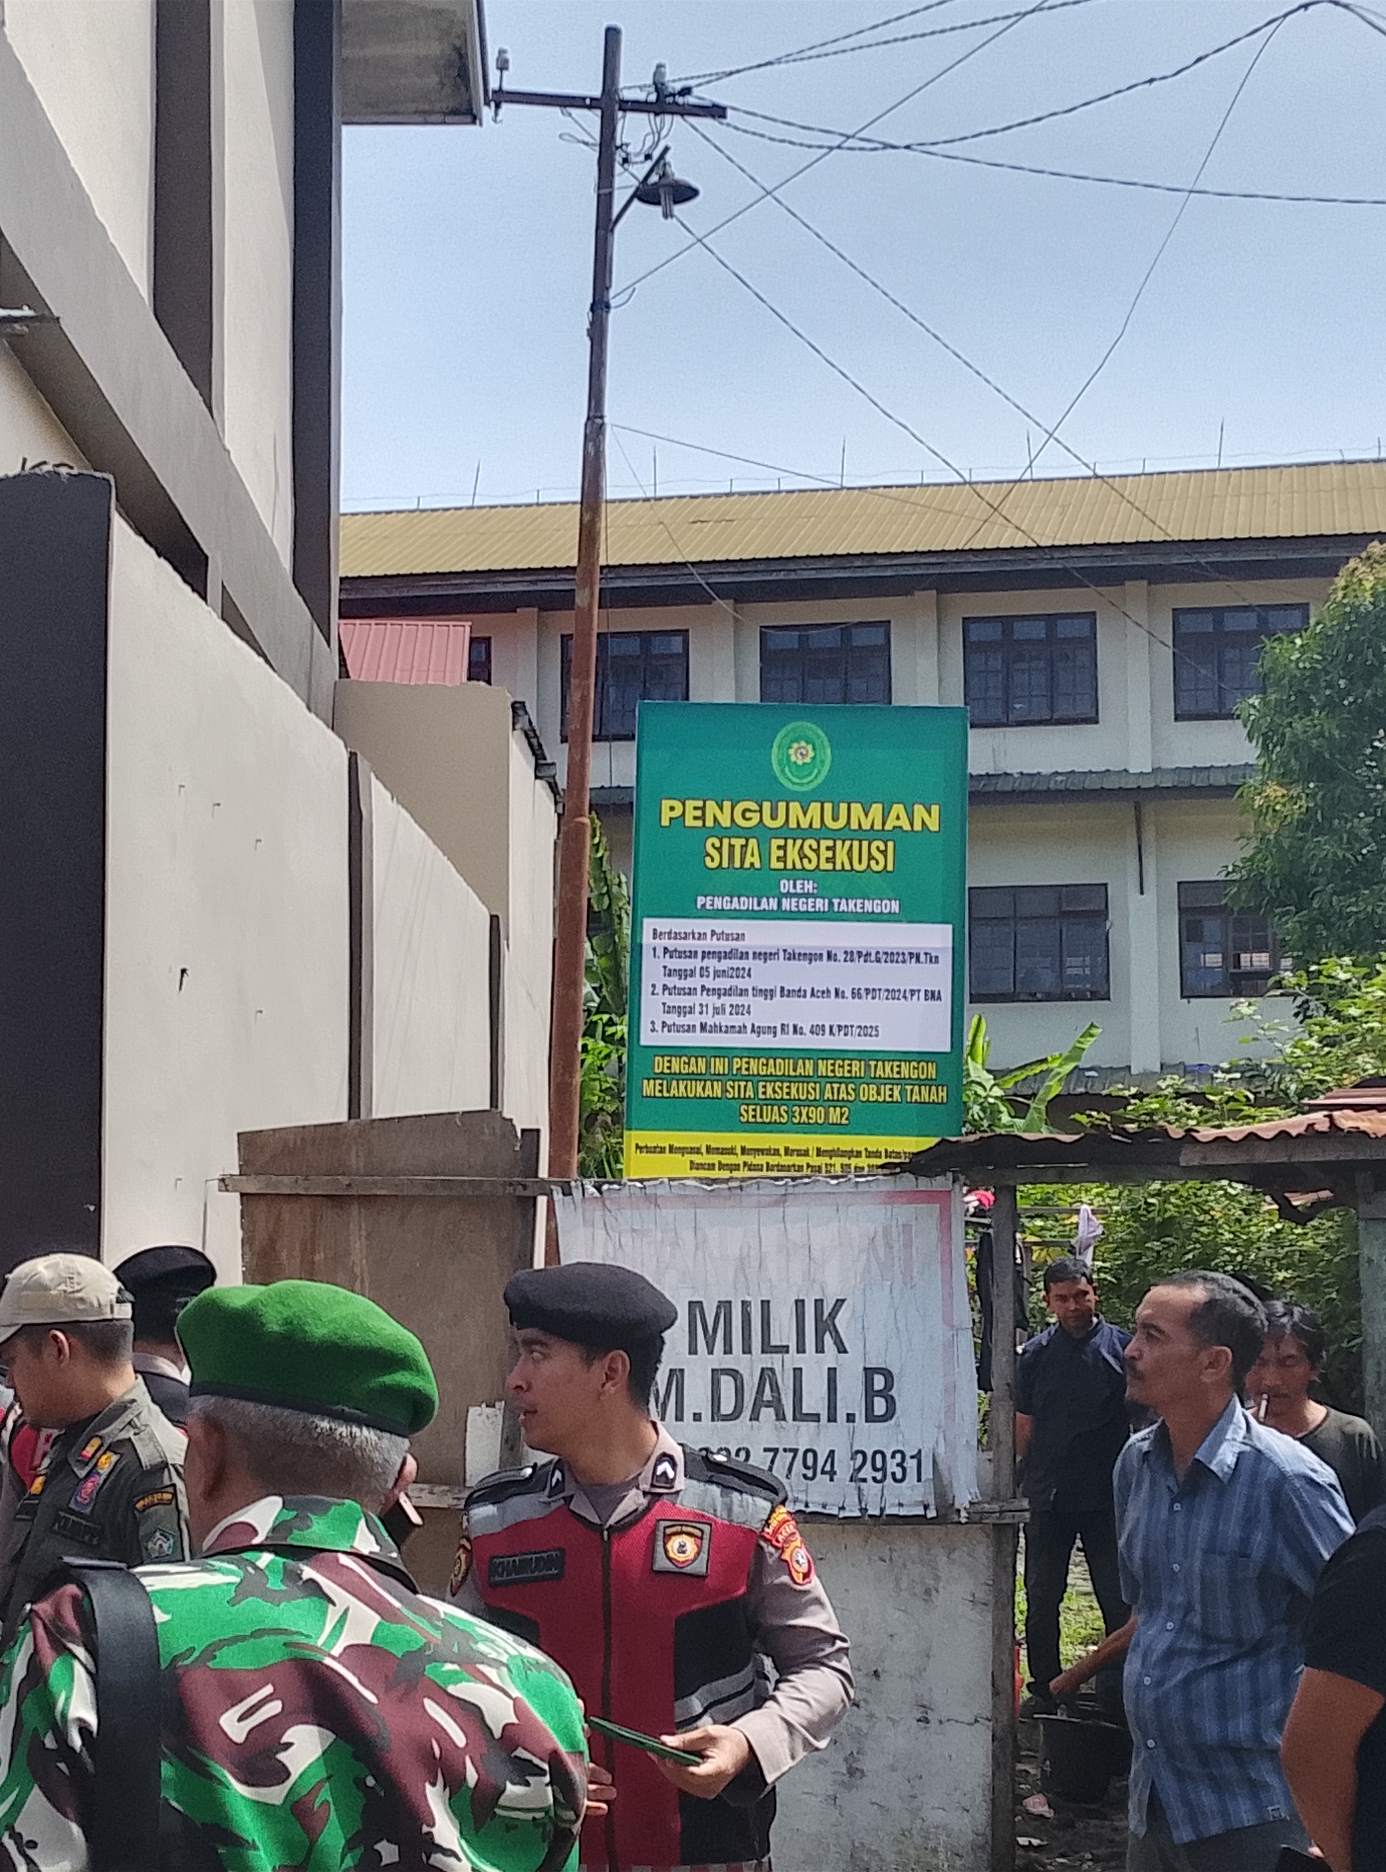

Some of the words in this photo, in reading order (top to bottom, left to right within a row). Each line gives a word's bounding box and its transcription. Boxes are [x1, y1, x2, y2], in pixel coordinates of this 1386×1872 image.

[660, 799, 940, 832] PENGUMUMAN
[704, 837, 761, 870] SITA
[769, 838, 895, 873] EKSEKUSI
[780, 879, 818, 894] OLEH:
[696, 896, 778, 911] PENGADILAN
[781, 897, 829, 912] NEGERI
[832, 898, 900, 914] TAKENGON
[652, 928, 707, 941] Berdasarkan
[710, 929, 746, 942] Putusan
[652, 947, 660, 959] 1.
[663, 947, 698, 959] Putusan
[701, 948, 749, 963] pengadilan
[752, 948, 779, 964] negeri
[782, 949, 823, 965] Takengon
[826, 950, 841, 963] No.
[662, 966, 696, 980] Tanggal
[699, 966, 710, 979] 05
[712, 966, 752, 981] juni2024
[651, 984, 659, 996] 2.
[662, 984, 697, 997] Putusan
[700, 985, 749, 1000] Pengadilan
[752, 986, 777, 1000] tinggi
[780, 986, 807, 999] Banda
[810, 987, 831, 999] Aceh
[834, 987, 849, 1000] No.
[924, 989, 942, 1002] BNA
[662, 1002, 695, 1017] Tanggal
[698, 1003, 709, 1015] 31
[712, 1003, 726, 1018] juli
[729, 1003, 751, 1016] 2024
[650, 1020, 658, 1033] 3.
[661, 1021, 696, 1034] Putusan
[699, 1021, 748, 1035] Mahkamah
[750, 1023, 777, 1038] Agung
[780, 1023, 790, 1035] RI
[792, 1023, 807, 1036] No.
[809, 1024, 826, 1037] 409
[653, 1056, 706, 1075] DENGAN
[710, 1057, 729, 1075] INI
[733, 1058, 814, 1077] PENGADILAN
[817, 1059, 865, 1078] NEGERI
[869, 1060, 937, 1080] TAKENGON
[642, 1079, 722, 1098] MELAKUKAN
[726, 1081, 754, 1099] SITA
[758, 1081, 820, 1100] EKSEKUSI
[824, 1083, 855, 1101] ATAS
[859, 1084, 902, 1103] OBJEK
[905, 1085, 947, 1103] TANAH
[740, 1104, 788, 1123] SELUAS
[792, 1106, 824, 1124] 3X90
[828, 1107, 850, 1124] M2
[688, 1298, 849, 1355] MILIK
[763, 1447, 838, 1483] 7794
[849, 1449, 924, 1484] 2931
